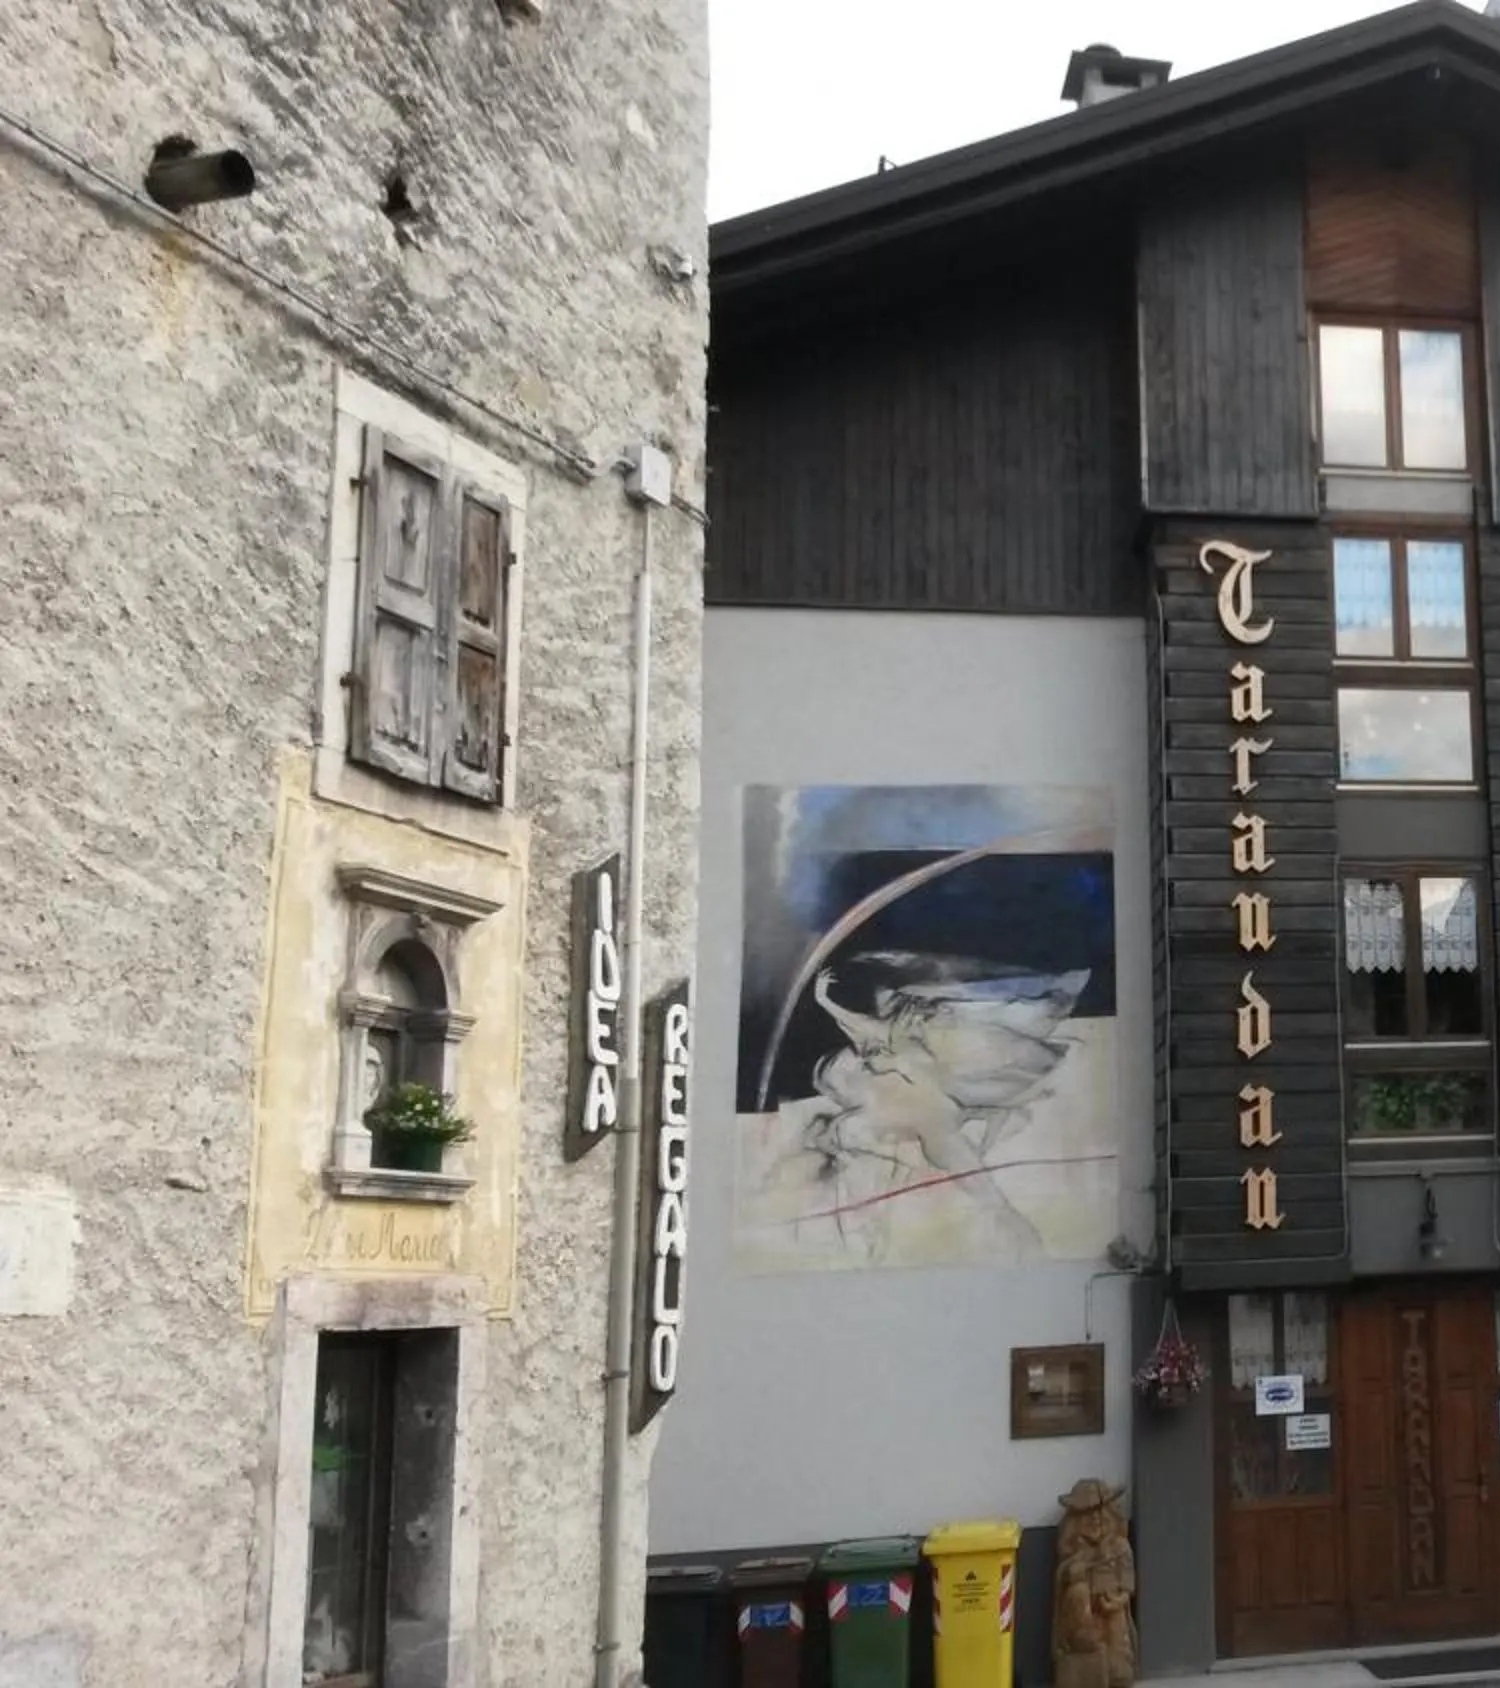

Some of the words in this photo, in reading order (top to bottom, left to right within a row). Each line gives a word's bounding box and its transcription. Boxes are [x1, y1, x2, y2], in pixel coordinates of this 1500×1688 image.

[582, 871, 619, 1133] IDEA
[1200, 539, 1286, 1230] Tarandan
[650, 1002, 691, 1393] REGALO
